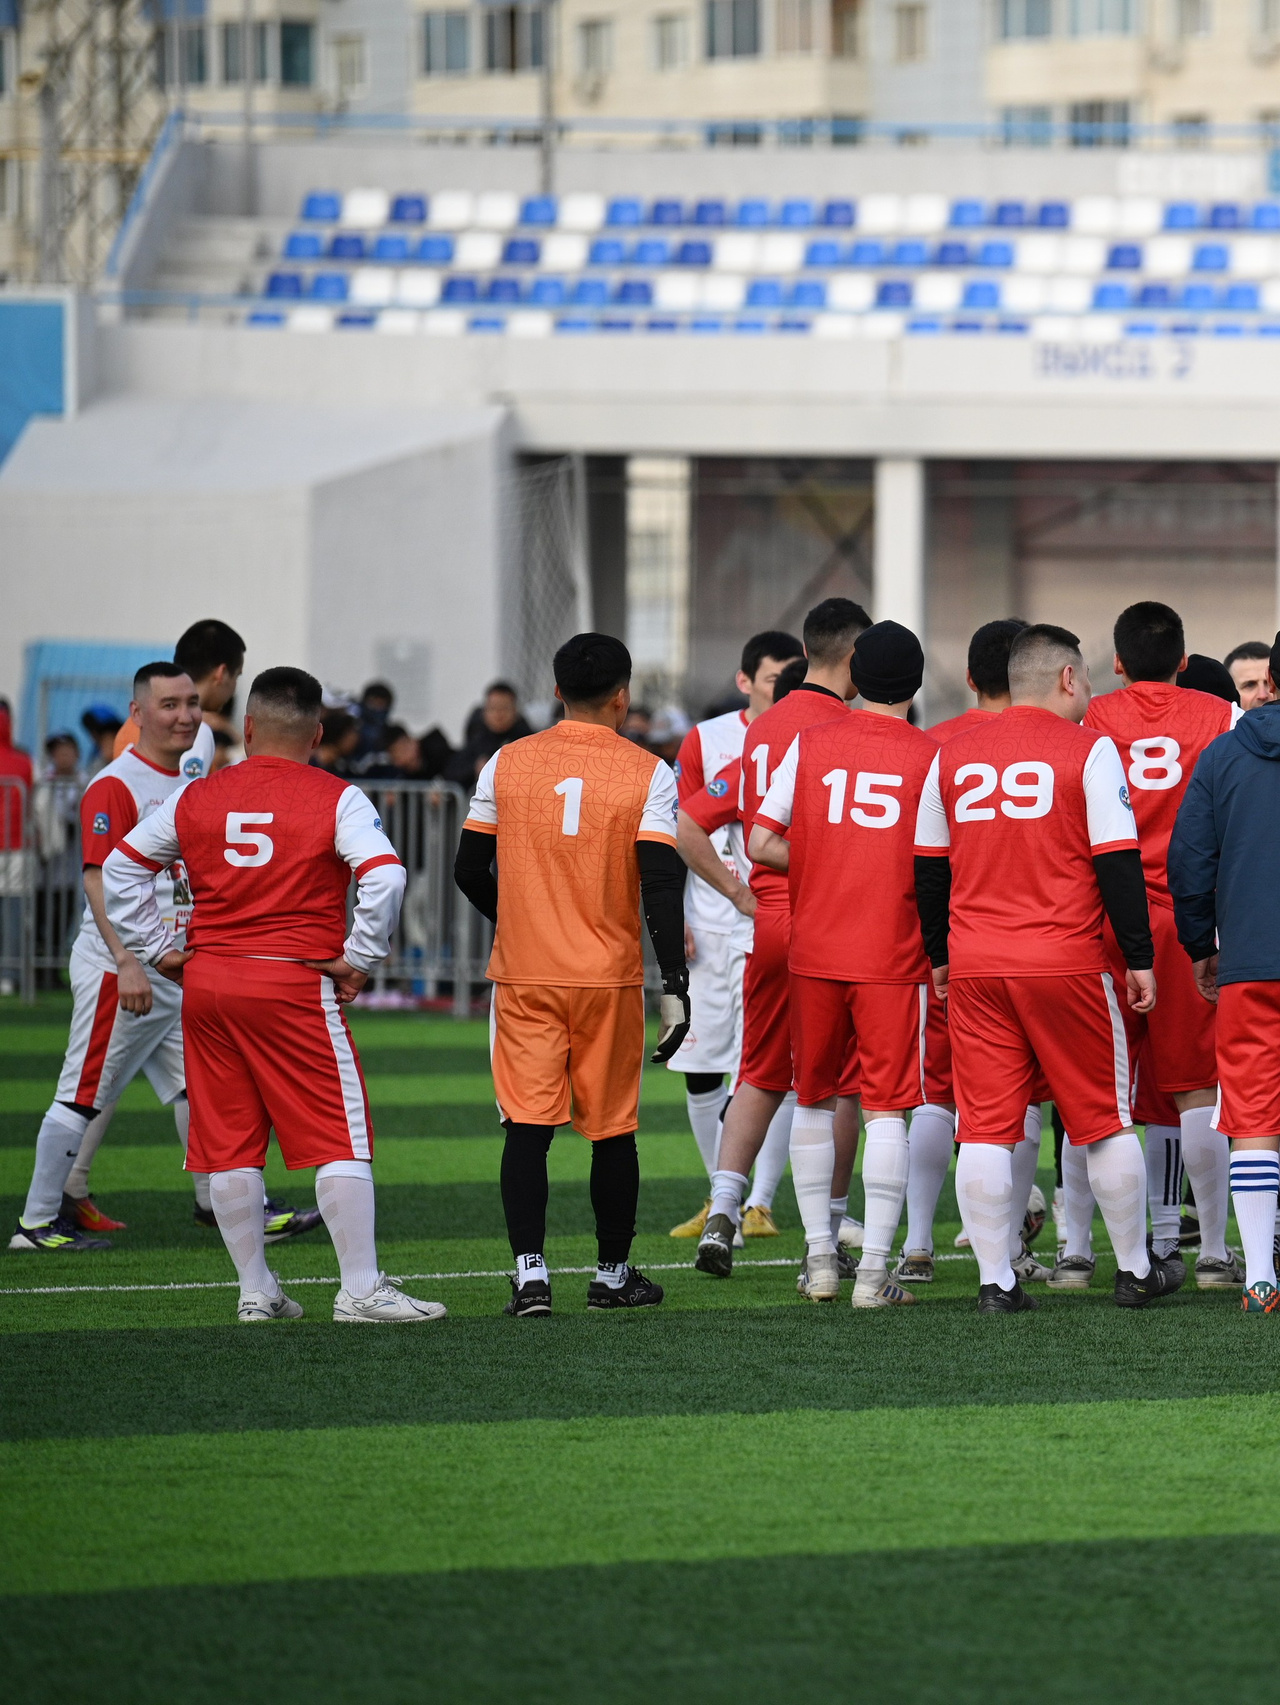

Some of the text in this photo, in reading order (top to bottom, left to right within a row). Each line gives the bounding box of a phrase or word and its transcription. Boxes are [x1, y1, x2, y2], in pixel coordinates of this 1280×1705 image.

[750, 743, 776, 797] 1
[953, 760, 1055, 823] 29
[1128, 735, 1183, 791] 8
[553, 776, 586, 837] 1
[821, 768, 903, 829] 15
[223, 811, 274, 868] 5
